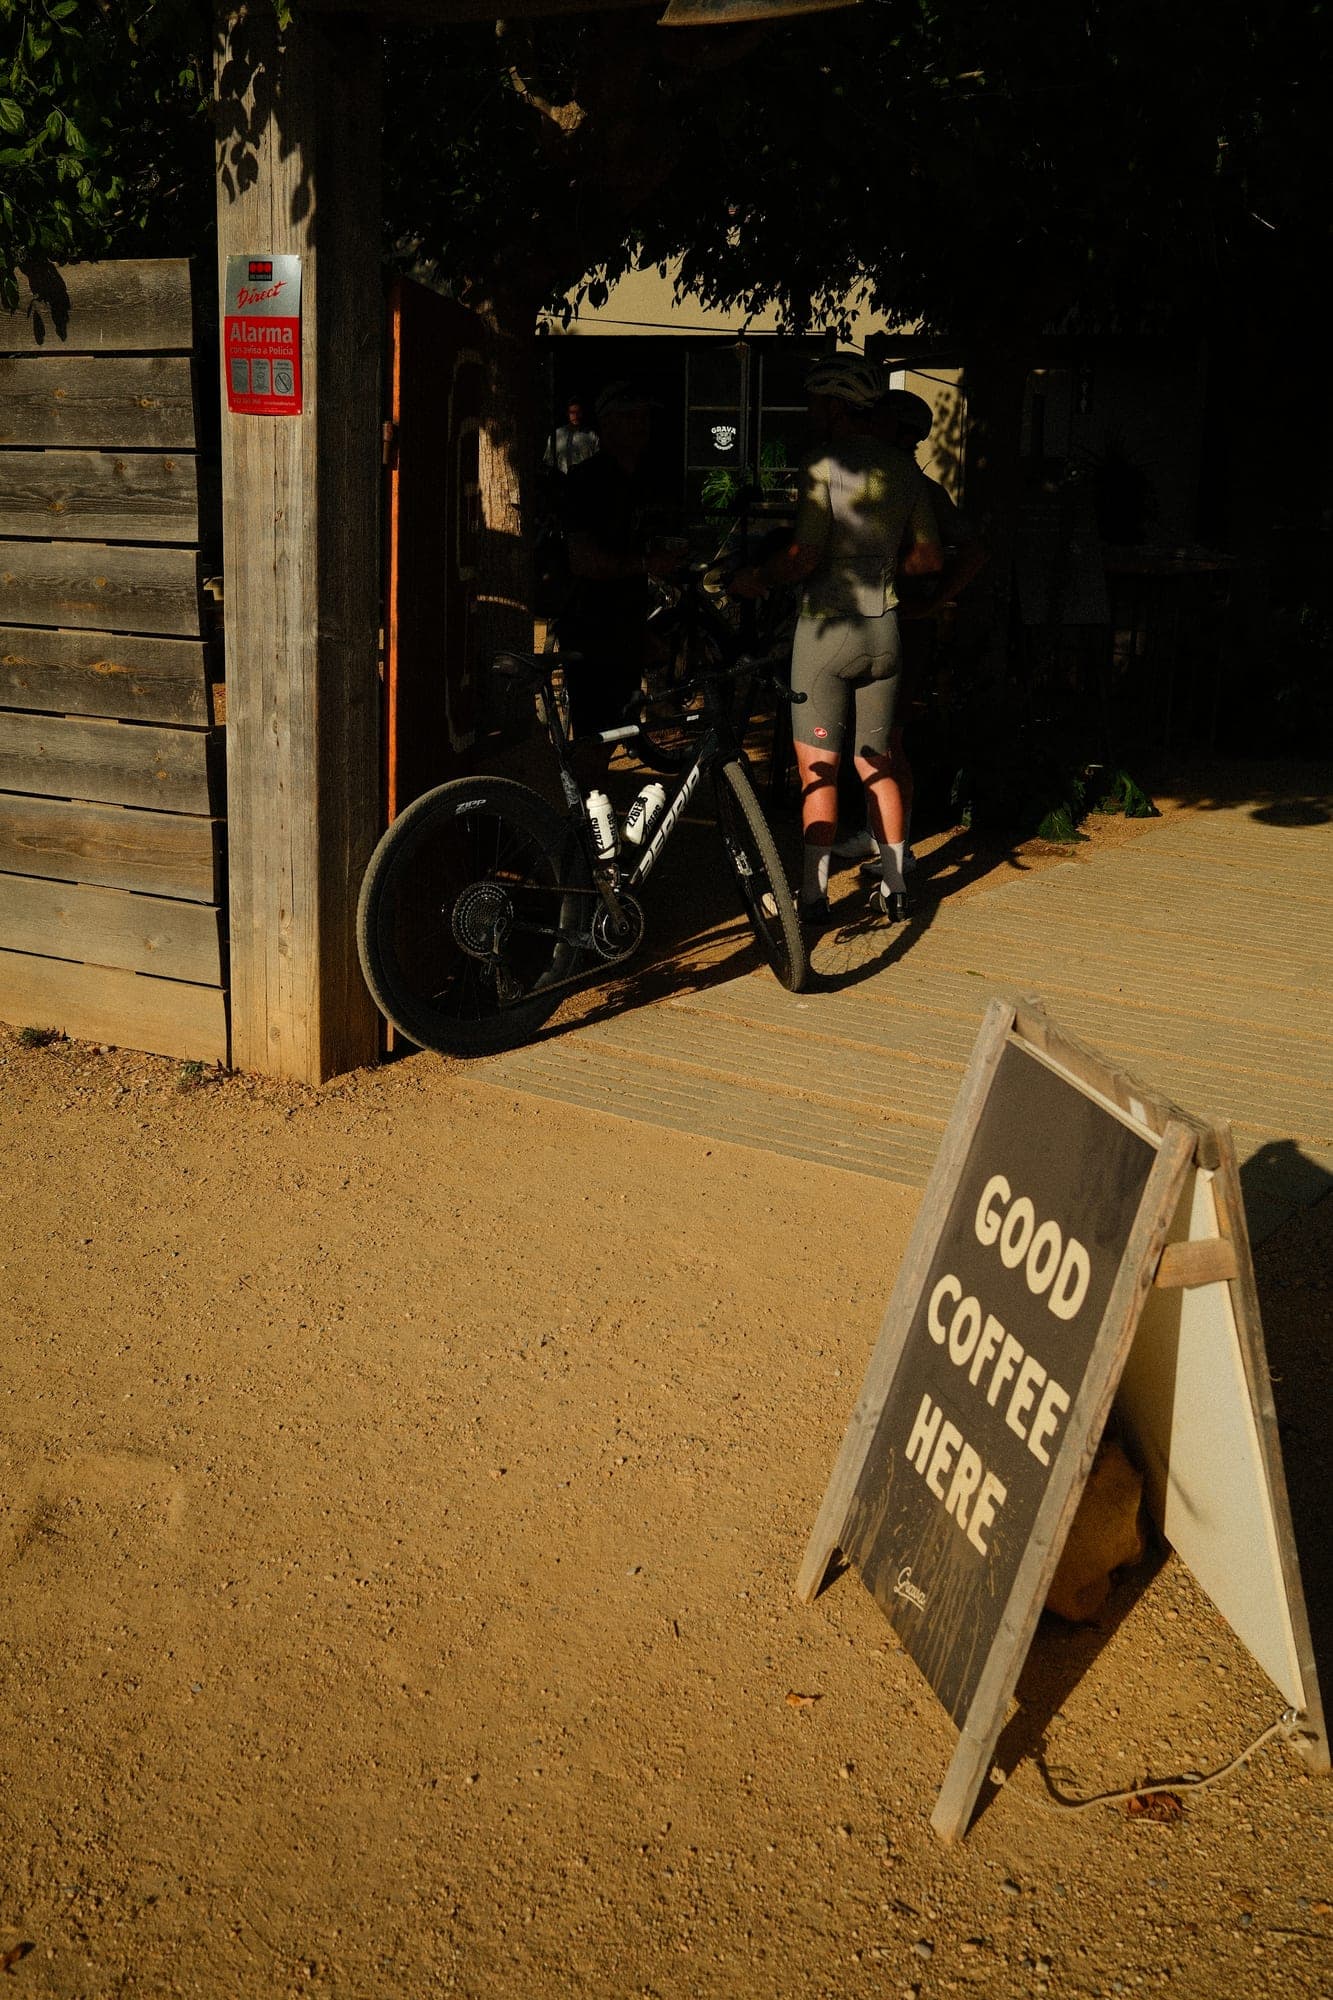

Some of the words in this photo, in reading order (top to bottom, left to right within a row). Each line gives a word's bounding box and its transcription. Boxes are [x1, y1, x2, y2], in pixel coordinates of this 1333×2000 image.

[230, 321, 293, 344] Alarma
[237, 280, 287, 309] Direct
[974, 1174, 1091, 1321] GOOD
[927, 1274, 1070, 1467] COFFEE
[904, 1393, 1007, 1557] HERE
